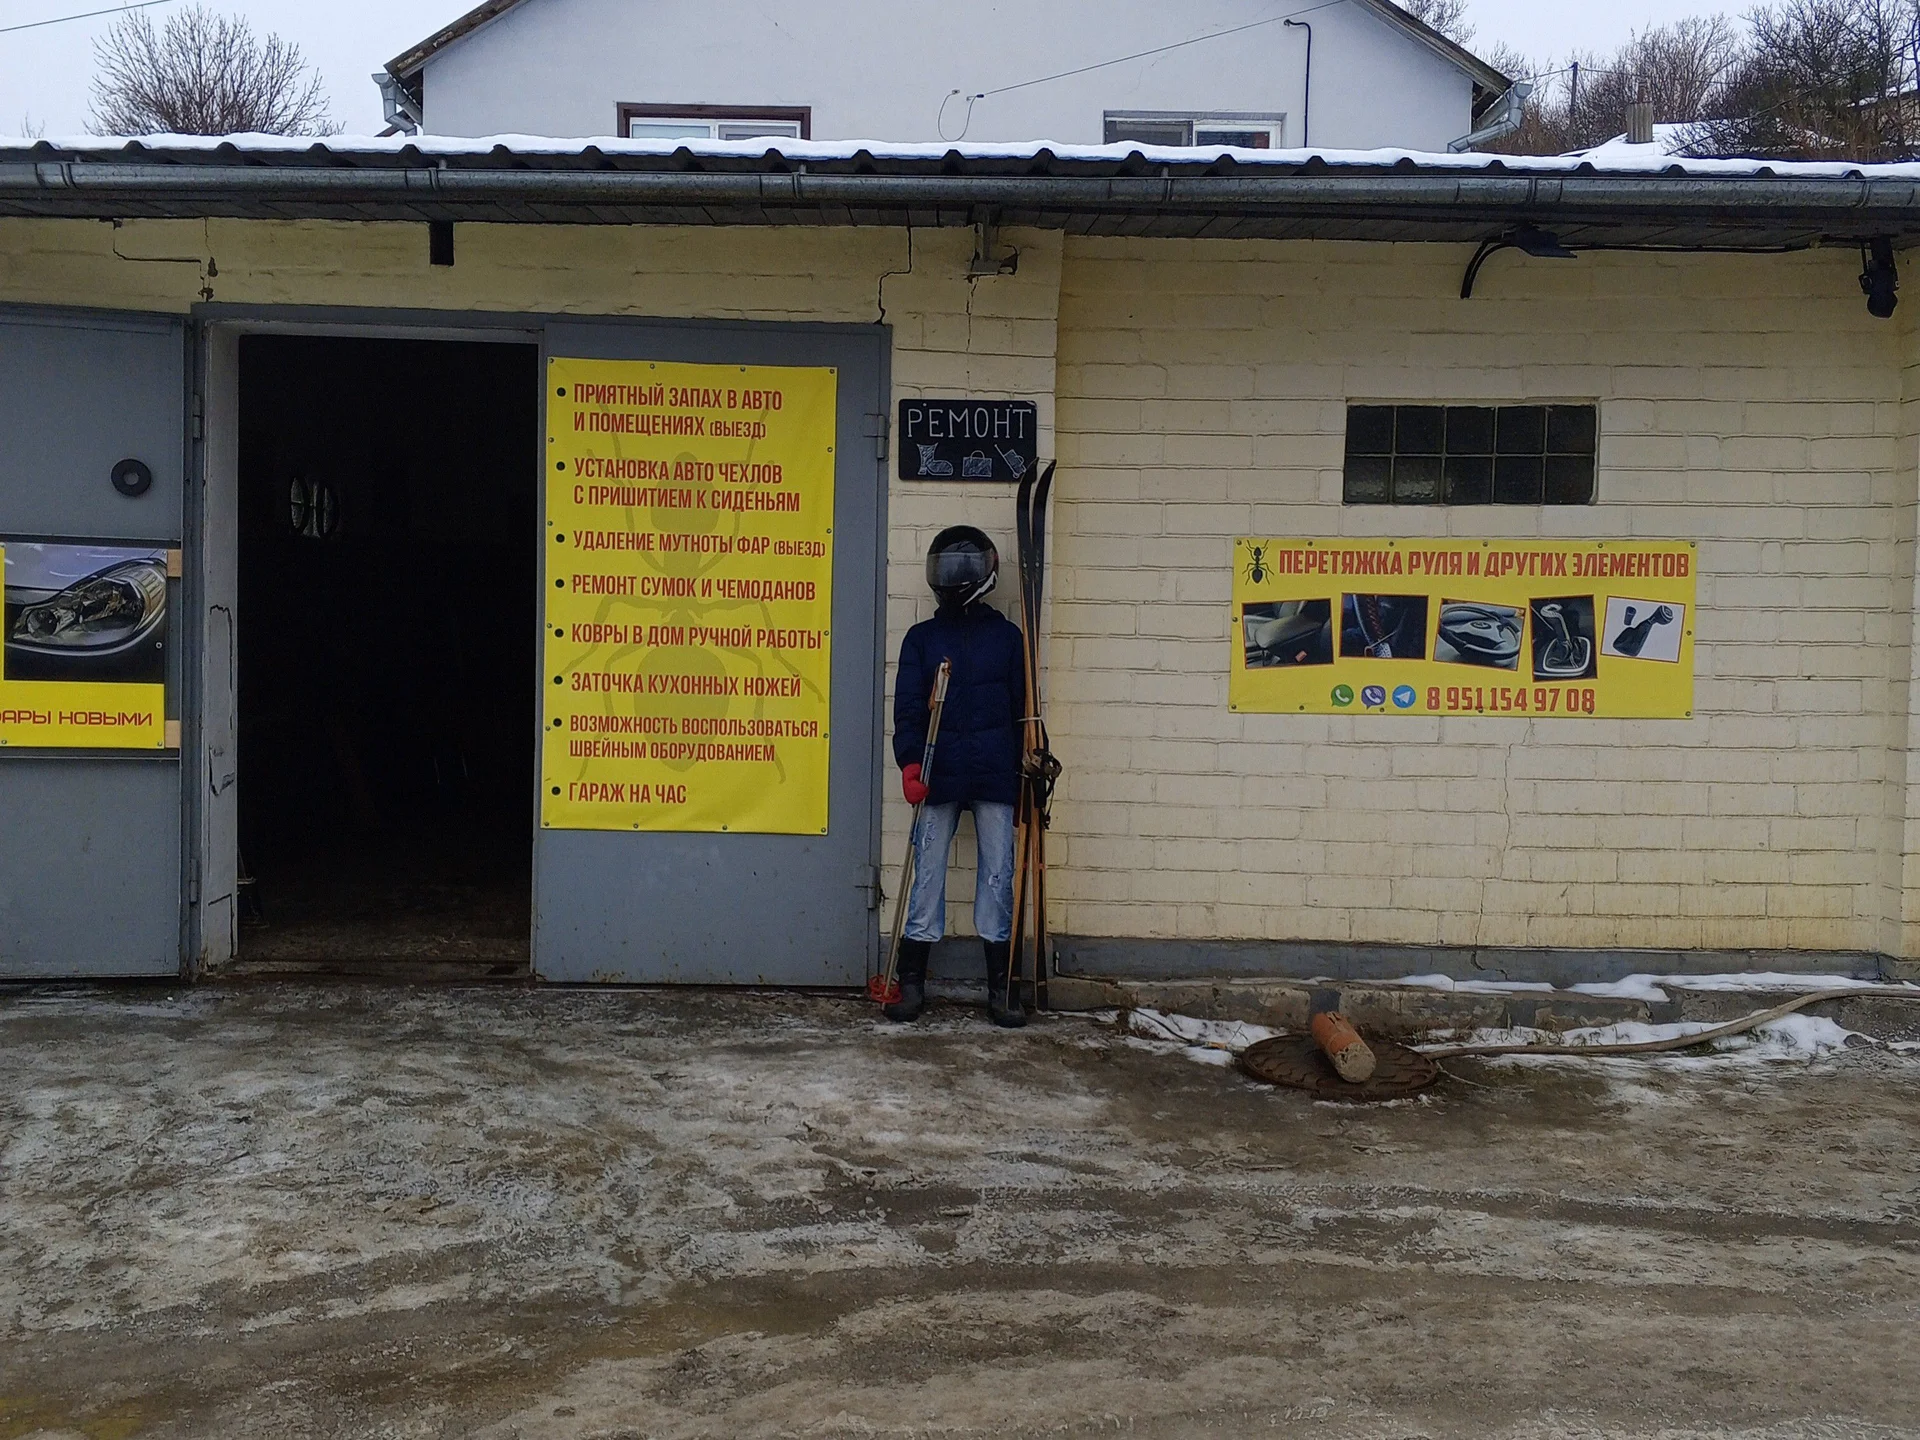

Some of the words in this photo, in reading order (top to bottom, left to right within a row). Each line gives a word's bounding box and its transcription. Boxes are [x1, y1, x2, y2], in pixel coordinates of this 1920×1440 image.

[574, 382, 664, 406] ПРИЯТНЫЙ
[669, 387, 722, 409] ЗАПАХ
[727, 390, 737, 408] В
[741, 391, 782, 411] АВТО
[574, 412, 585, 431] И
[589, 413, 705, 436] ПОМЕЩЕНИЯХ
[709, 421, 766, 440] (ВЫЕЗД)
[908, 408, 1032, 439] РЕМОНТ
[574, 458, 668, 480] УСТАНОВКА
[673, 463, 714, 482] АВТО
[718, 464, 782, 484] ЧЕХЛОВ
[574, 486, 584, 504] С
[588, 487, 692, 509] ПРИШИТИЕМ
[696, 490, 706, 508] К
[711, 491, 800, 512] СИДЕНЬЯМ
[573, 531, 654, 551] УДАЛЕНИЕ
[659, 534, 733, 553] МУТНОТЫ
[737, 536, 770, 555] ФАР
[773, 540, 826, 558] (ВЫЕЗД)
[1279, 550, 1403, 575] ПЕРЕТЯЖКА
[1408, 551, 1463, 576] РУЛЯ
[1467, 553, 1480, 575] И
[1484, 552, 1567, 578] ДРУГИХ
[1572, 553, 1689, 578] ЭЛЕМЕНТОВ
[572, 574, 637, 595] РЕМОНТ
[641, 577, 697, 597] СУМОК
[701, 579, 712, 597] И
[716, 580, 816, 601] ЧЕМОДАНОВ
[571, 623, 628, 643] КОВРЫ
[632, 626, 643, 644] В
[647, 627, 684, 647] ДОМ
[688, 625, 752, 648] РУЧНОЙ
[756, 629, 822, 650] РАБОТЫ
[571, 672, 644, 693] ЗАТОЧКА
[648, 675, 739, 696] КУХОННЫХ
[743, 673, 801, 697] НОЖЕЙ
[1427, 687, 1439, 710] 8
[1446, 687, 1485, 710] 951
[1489, 688, 1527, 711] 154
[1534, 688, 1561, 712] 97
[1566, 687, 1596, 712] 08
[0, 710, 51, 725] АРЫ
[59, 711, 152, 726] НОВЫМИ
[570, 715, 678, 734] ВОЗМОЖНОСТЬ
[682, 718, 819, 738] ВОСПОЛЬЗОВАТЬСЯ
[569, 738, 647, 759] ШВЕЙНЫМ
[650, 742, 775, 762] ОБОРУДОВАНИЕМ
[569, 782, 625, 803] ГАРАЖ
[629, 784, 651, 803] НА
[655, 784, 687, 804] ЧАС
